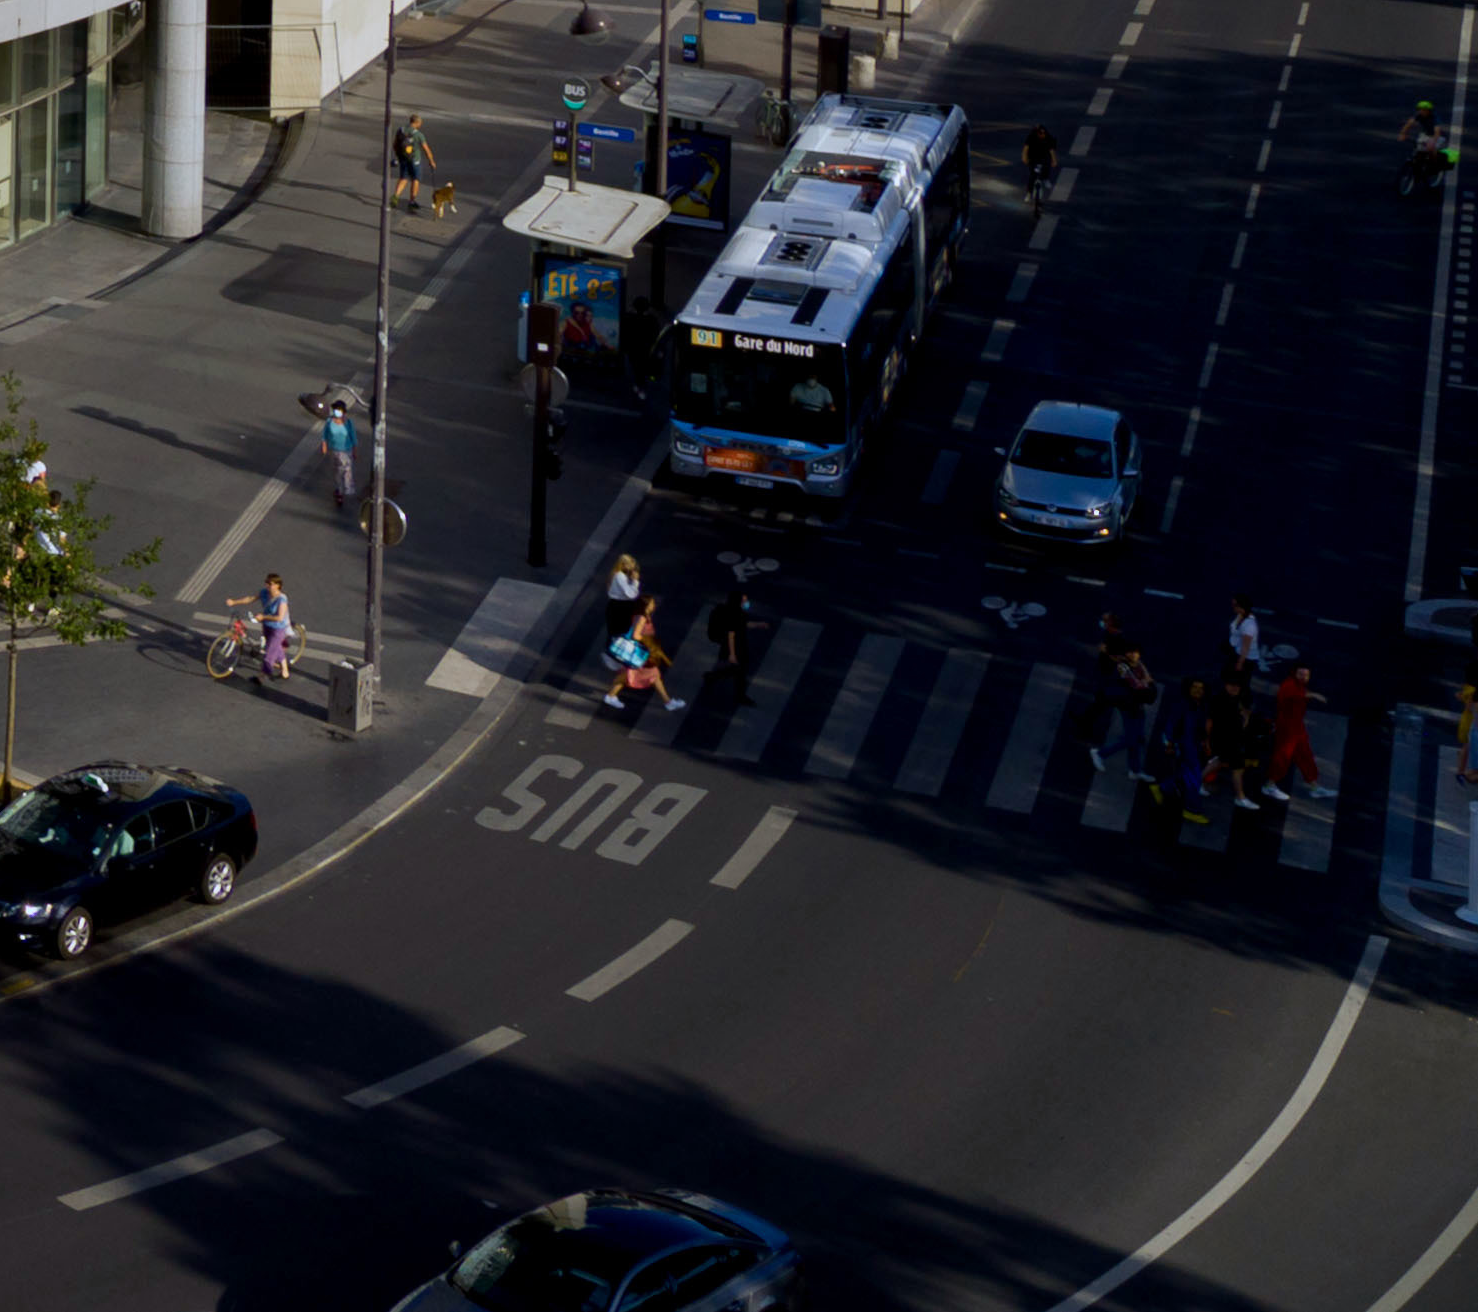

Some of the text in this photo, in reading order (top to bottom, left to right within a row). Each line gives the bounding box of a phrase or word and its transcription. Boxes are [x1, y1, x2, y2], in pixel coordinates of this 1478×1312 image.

[564, 82, 586, 97] BUS
[734, 334, 763, 351] Gare
[766, 339, 782, 354] du
[784, 341, 814, 358] Nord
[473, 754, 710, 867] BUS
